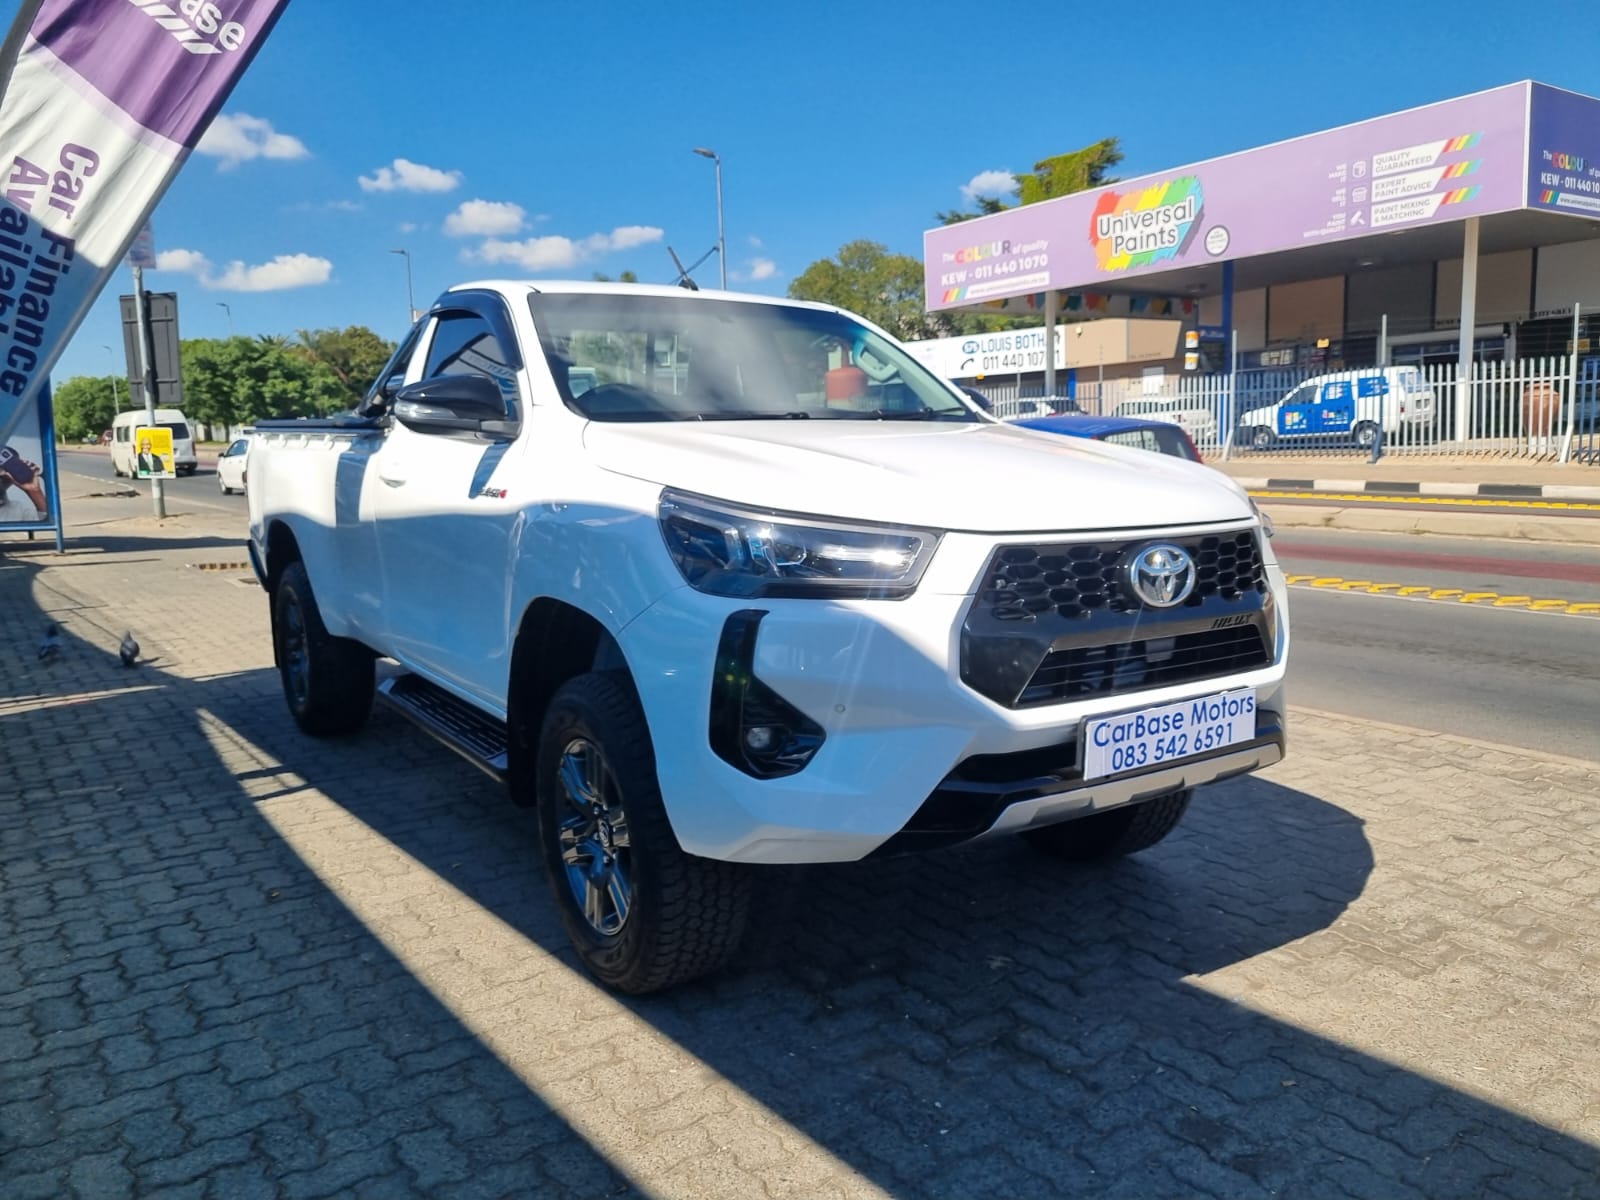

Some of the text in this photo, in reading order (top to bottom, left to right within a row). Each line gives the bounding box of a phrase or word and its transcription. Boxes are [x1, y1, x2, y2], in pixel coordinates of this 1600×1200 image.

[1375, 151, 1410, 165] QUALITY
[1375, 154, 1433, 173] GUARANTEED
[1374, 180, 1433, 199] PAINT ADVICE
[1375, 177, 1406, 190] EXPERT
[1541, 171, 1560, 187] KEW
[1564, 176, 1576, 190] 011
[1577, 178, 1591, 192] 440
[1374, 198, 1431, 215] PAINT MIXING
[1381, 208, 1424, 222] MATCHING
[1100, 199, 1192, 236] Universal
[1114, 226, 1176, 254] Paints
[955, 240, 1011, 265] COLOUR
[1, 143, 100, 397] Car Finance
[941, 270, 967, 286] KEW
[975, 265, 992, 280] 011
[994, 260, 1017, 275] 440
[1019, 253, 1049, 271] 1070
[981, 336, 1012, 353] LOUIS
[1015, 331, 1047, 351] BOTH
[983, 355, 998, 370] 011
[1002, 352, 1024, 367] 440
[1094, 696, 1254, 748] CarBase Motors
[1112, 722, 1232, 770] 083 542 6591
